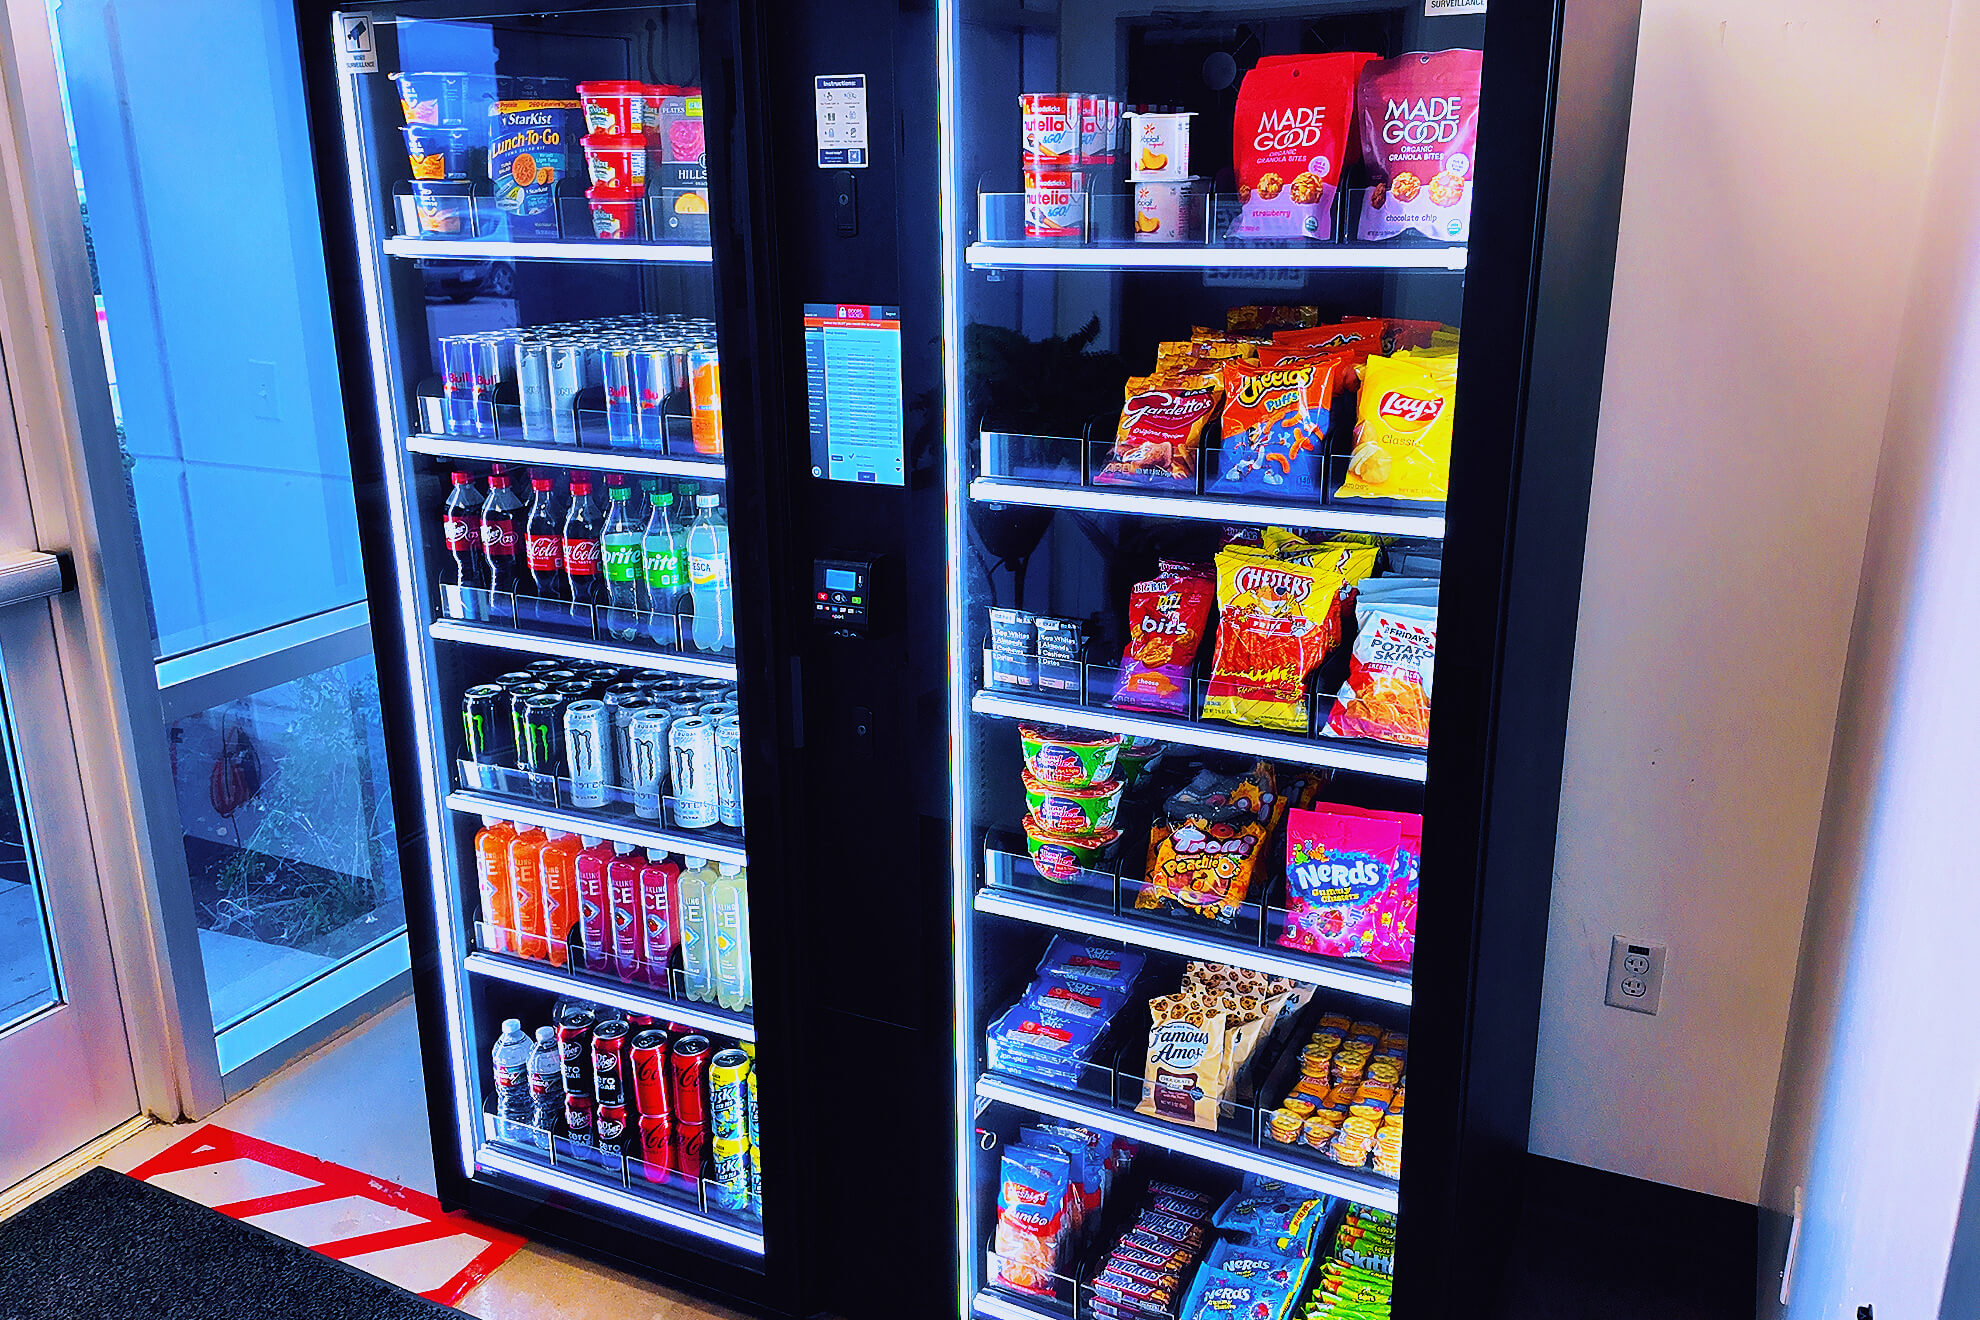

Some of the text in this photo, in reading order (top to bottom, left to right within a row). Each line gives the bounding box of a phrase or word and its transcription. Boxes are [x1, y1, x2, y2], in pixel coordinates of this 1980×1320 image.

[1431, 0, 1485, 8] SURVEILLANCE
[1384, 97, 1462, 121] MADE
[508, 112, 552, 125] StarKist
[1258, 106, 1326, 133] MADE
[1254, 127, 1321, 151] GOOD
[1383, 120, 1459, 144] GOOD
[492, 128, 560, 158] Lunch-To-Go
[1424, 153, 1444, 161] BITES
[1252, 209, 1291, 218] strawberry
[1386, 214, 1438, 223] chocolate chip
[449, 371, 470, 383] Bull
[477, 374, 497, 385] Bull
[1239, 367, 1314, 404] Cheetos
[1122, 391, 1212, 430] Gardetto's
[1265, 392, 1299, 412] Puffs
[1382, 434, 1421, 447] Classic
[1235, 566, 1315, 603] CHESTER'S
[1142, 615, 1189, 635] bits
[1008, 631, 1029, 639] Whites
[1054, 637, 1075, 645] Whites
[1389, 628, 1430, 643] FRIDAYS
[1042, 643, 1069, 652] Almonds
[1043, 650, 1070, 659] Cashews
[1371, 638, 1435, 658] POTATO
[1043, 659, 1060, 667] Dates
[1374, 650, 1425, 667] SKINS
[1136, 679, 1160, 687] cheese
[1173, 824, 1256, 854] Trolli
[1163, 857, 1219, 877] Peachie
[1149, 1026, 1209, 1048] Famous
[1151, 1043, 1203, 1063] Amos
[564, 1066, 580, 1074] ero
[598, 1077, 616, 1085] ero
[1111, 1260, 1161, 1281] SNICKERS
[1101, 1275, 1152, 1295] SNICKERS
